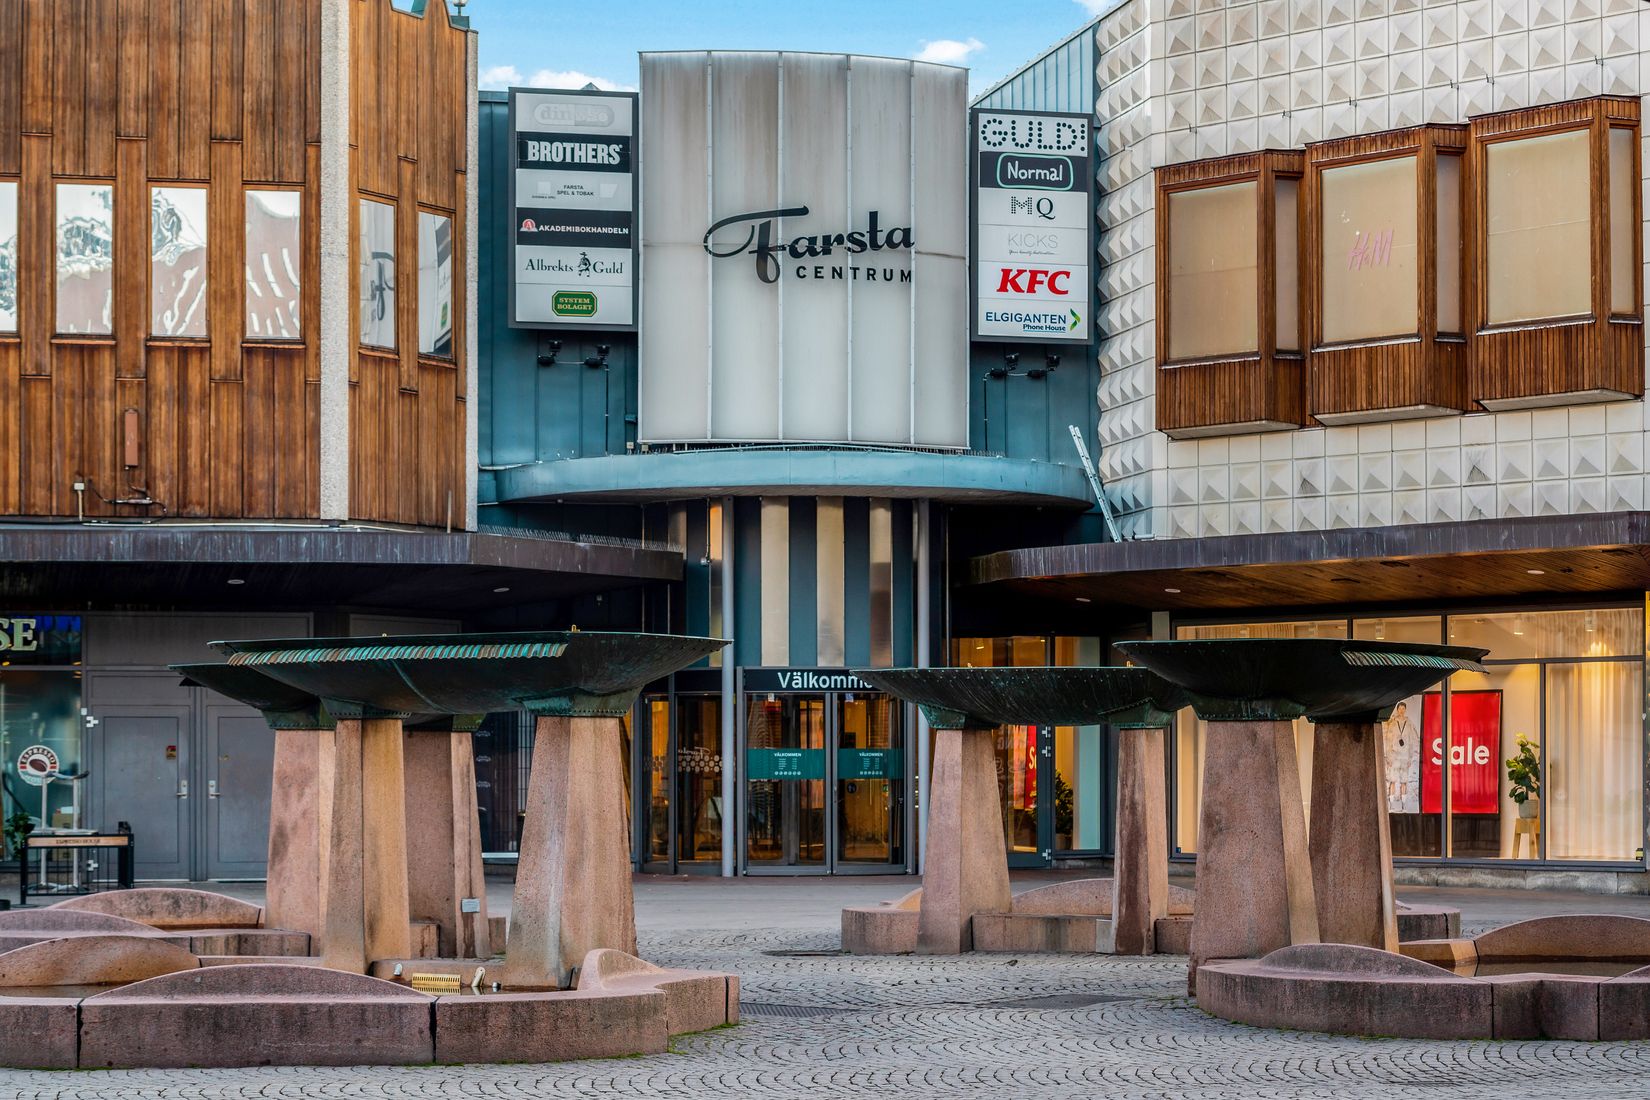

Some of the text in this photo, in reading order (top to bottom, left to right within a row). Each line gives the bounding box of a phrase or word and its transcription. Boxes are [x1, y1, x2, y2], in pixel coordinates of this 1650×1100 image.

[981, 118, 1085, 151] GULD!
[527, 140, 622, 165] BROTHERS
[1007, 161, 1063, 181] Normal
[538, 225, 629, 234] AKADEMIBOKHANDELN
[703, 205, 915, 284] Farsta
[1008, 232, 1058, 249] KICKS
[525, 258, 623, 274] Albrekts Guld
[796, 265, 912, 283] CENTRUM
[996, 268, 1071, 295] KFC
[985, 311, 1066, 324] ELGIGANTEN
[1023, 323, 1066, 332] Phone House
[1431, 736, 1490, 766] Sale
